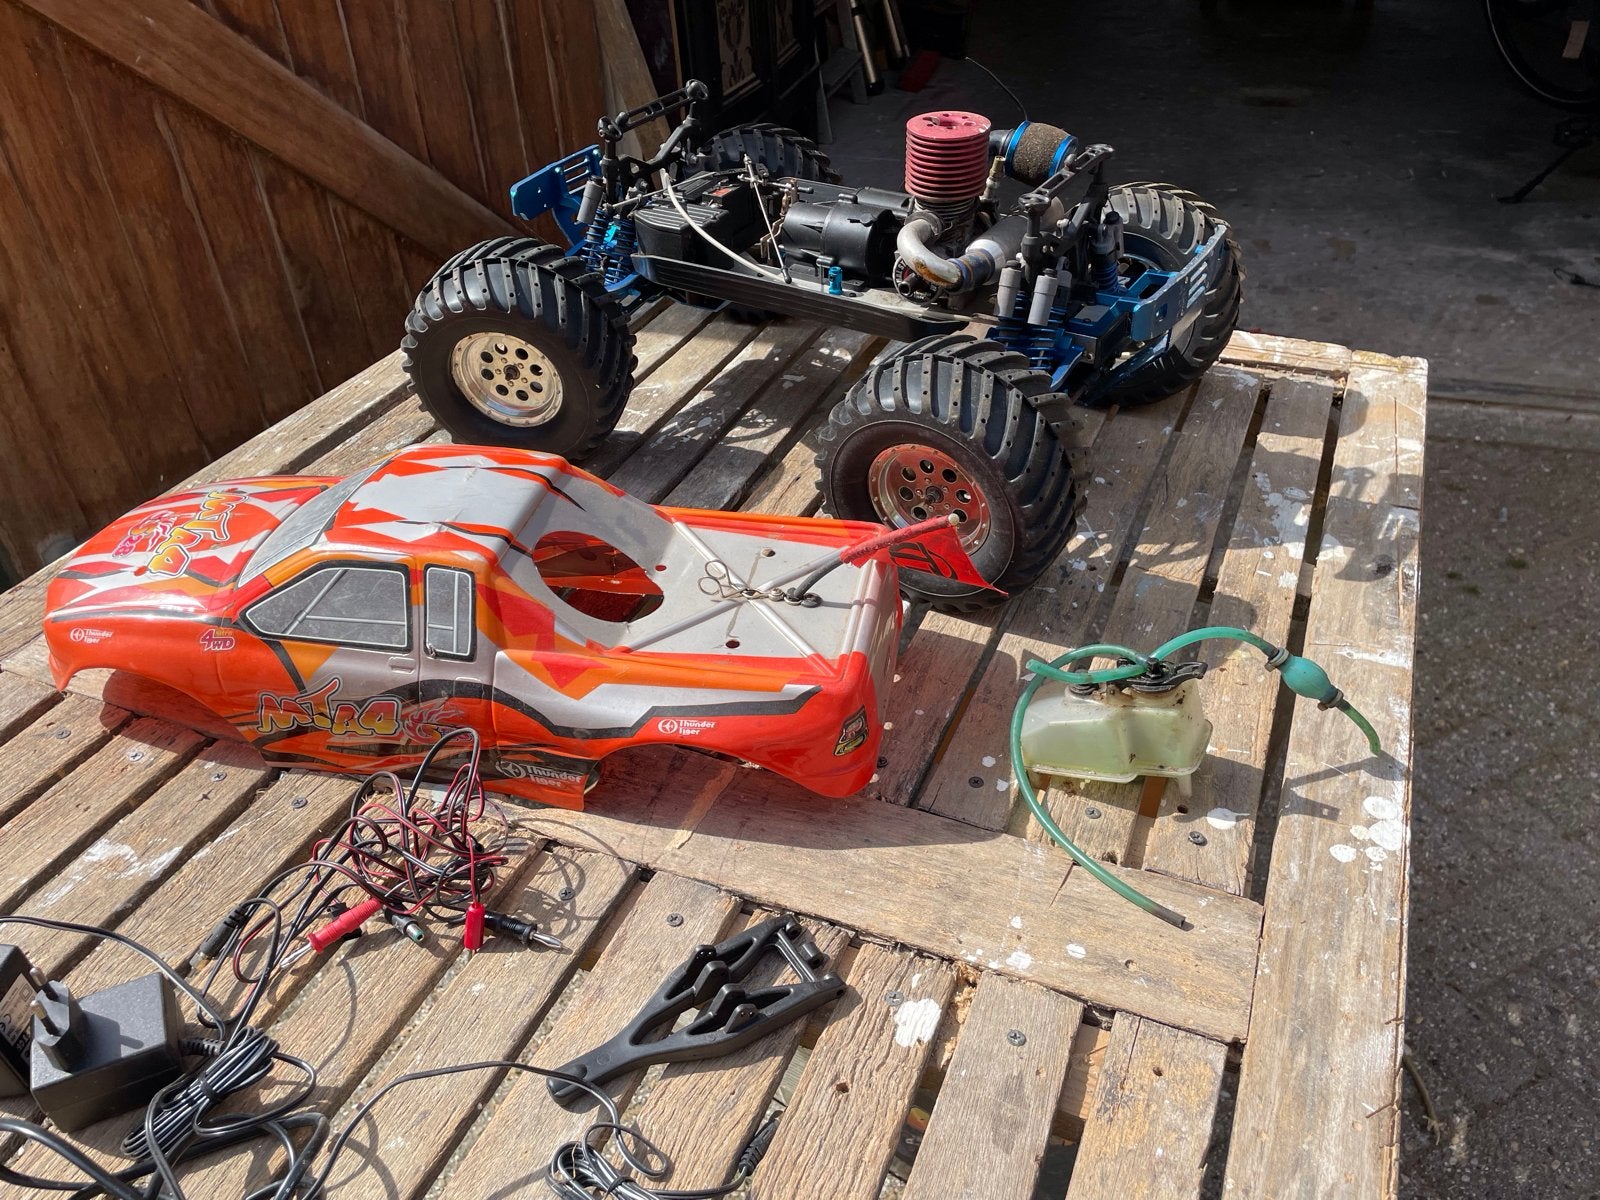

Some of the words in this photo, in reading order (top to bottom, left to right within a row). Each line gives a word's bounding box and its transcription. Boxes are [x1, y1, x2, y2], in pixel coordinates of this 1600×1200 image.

[84, 628, 114, 638] Thunder
[84, 636, 101, 644] Tiger
[200, 629, 235, 651] 4WD
[678, 719, 716, 729] Thunder
[679, 727, 701, 736] Tiger
[525, 765, 583, 783] Thunder
[529, 774, 563, 788] Tiger
